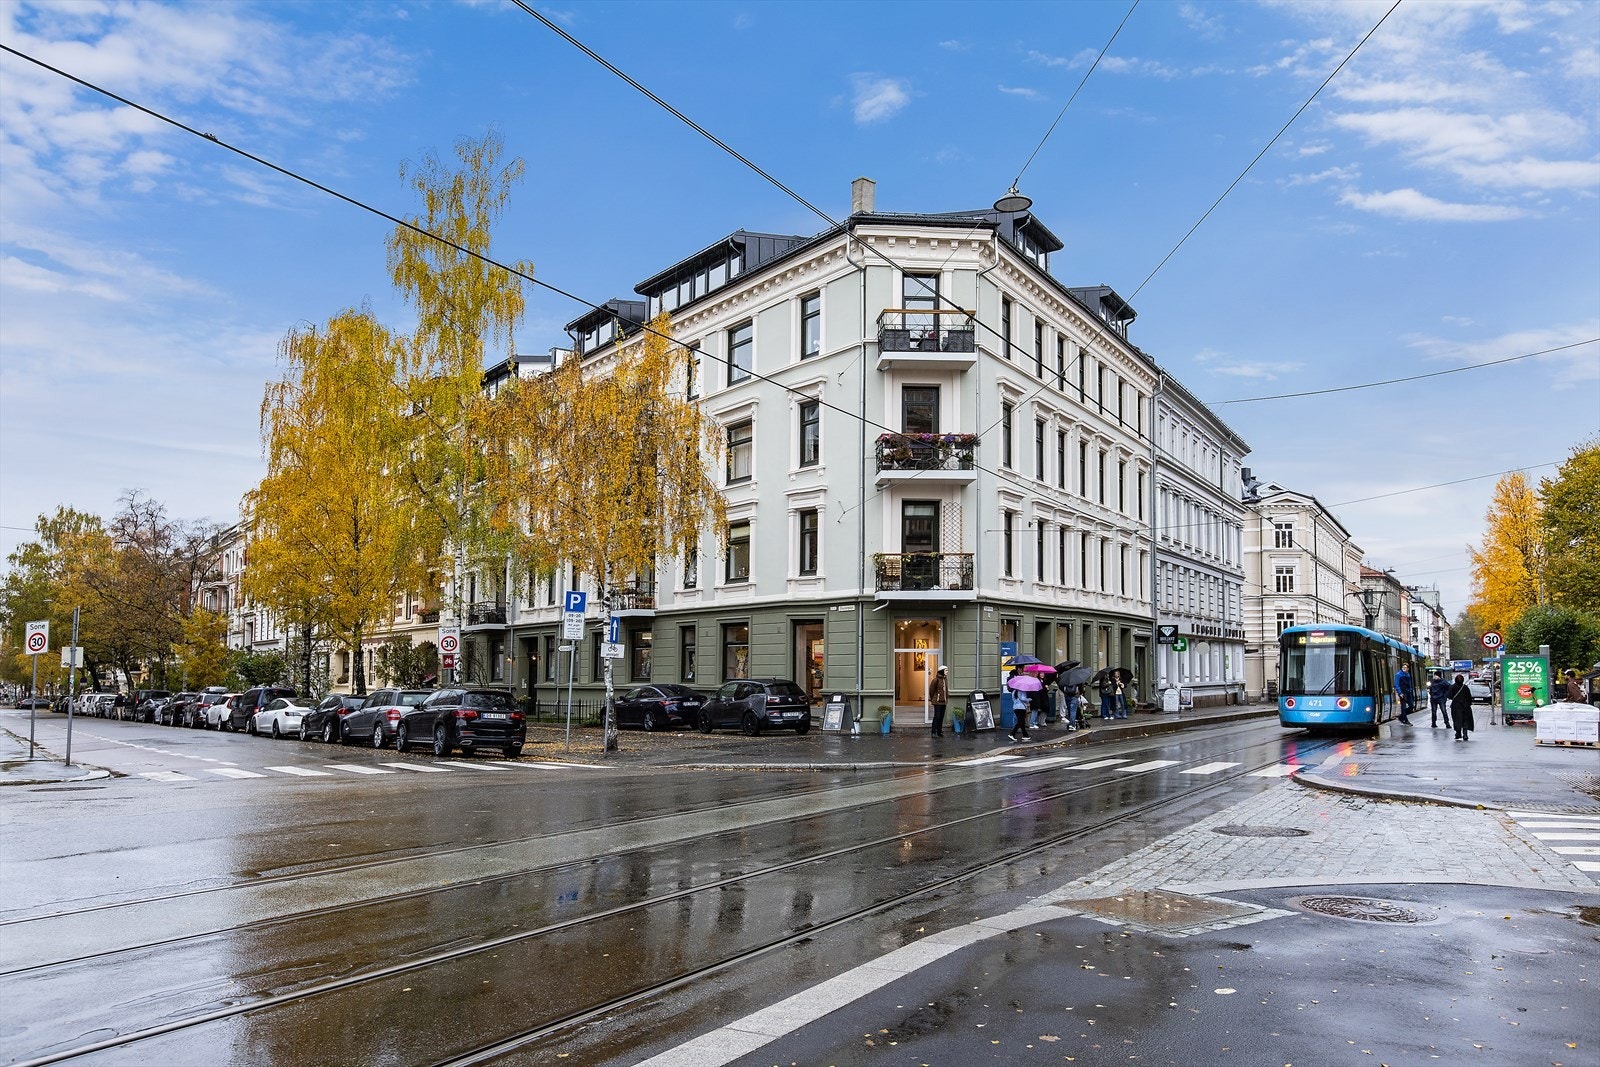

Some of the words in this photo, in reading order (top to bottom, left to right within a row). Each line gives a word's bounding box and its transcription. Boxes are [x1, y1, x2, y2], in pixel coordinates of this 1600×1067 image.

[570, 594, 582, 610] P
[32, 637, 43, 647] 30
[444, 640, 454, 648] 30
[1484, 636, 1498, 644] 30
[1507, 661, 1542, 674] 25%
